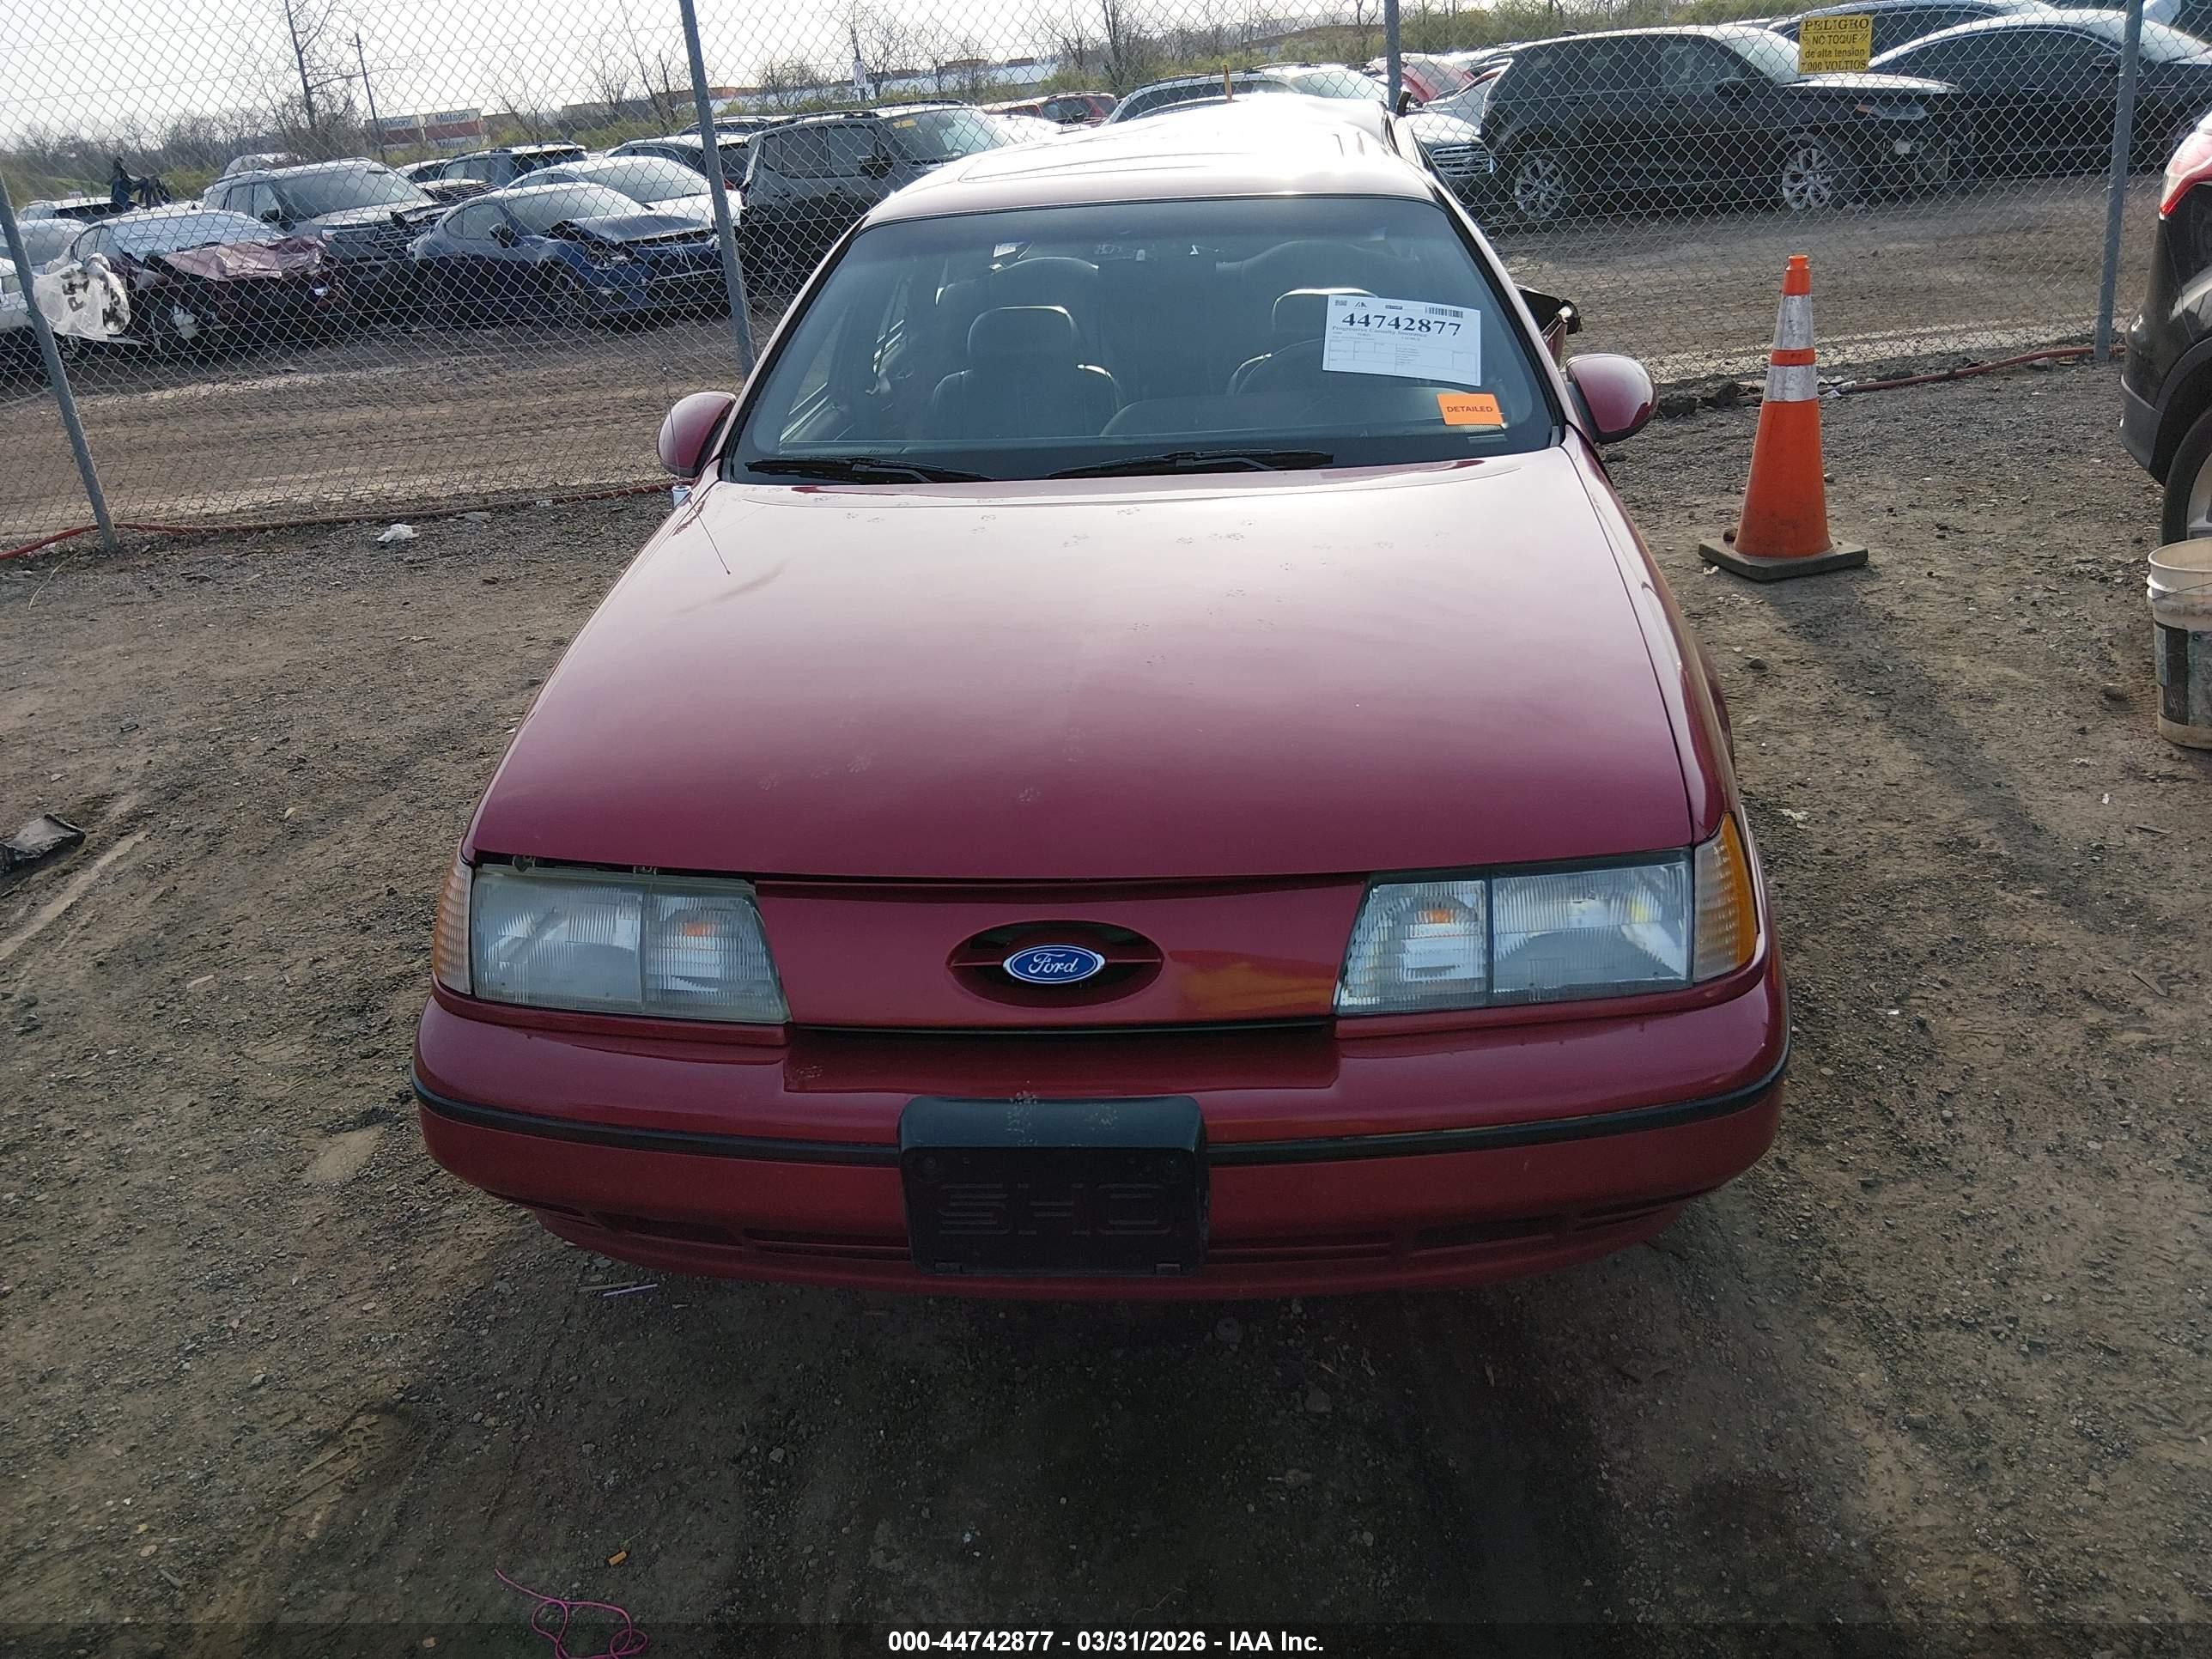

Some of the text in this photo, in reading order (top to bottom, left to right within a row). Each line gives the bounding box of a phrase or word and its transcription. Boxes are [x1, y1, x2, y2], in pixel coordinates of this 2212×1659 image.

[1804, 19, 1869, 31] PELIGRO
[1826, 33, 1858, 45] TOQUE
[1805, 48, 1815, 58] de
[1825, 60, 1866, 70] VOLTIOS
[1341, 313, 1462, 337] 44742877
[1028, 952, 1079, 974] Ford
